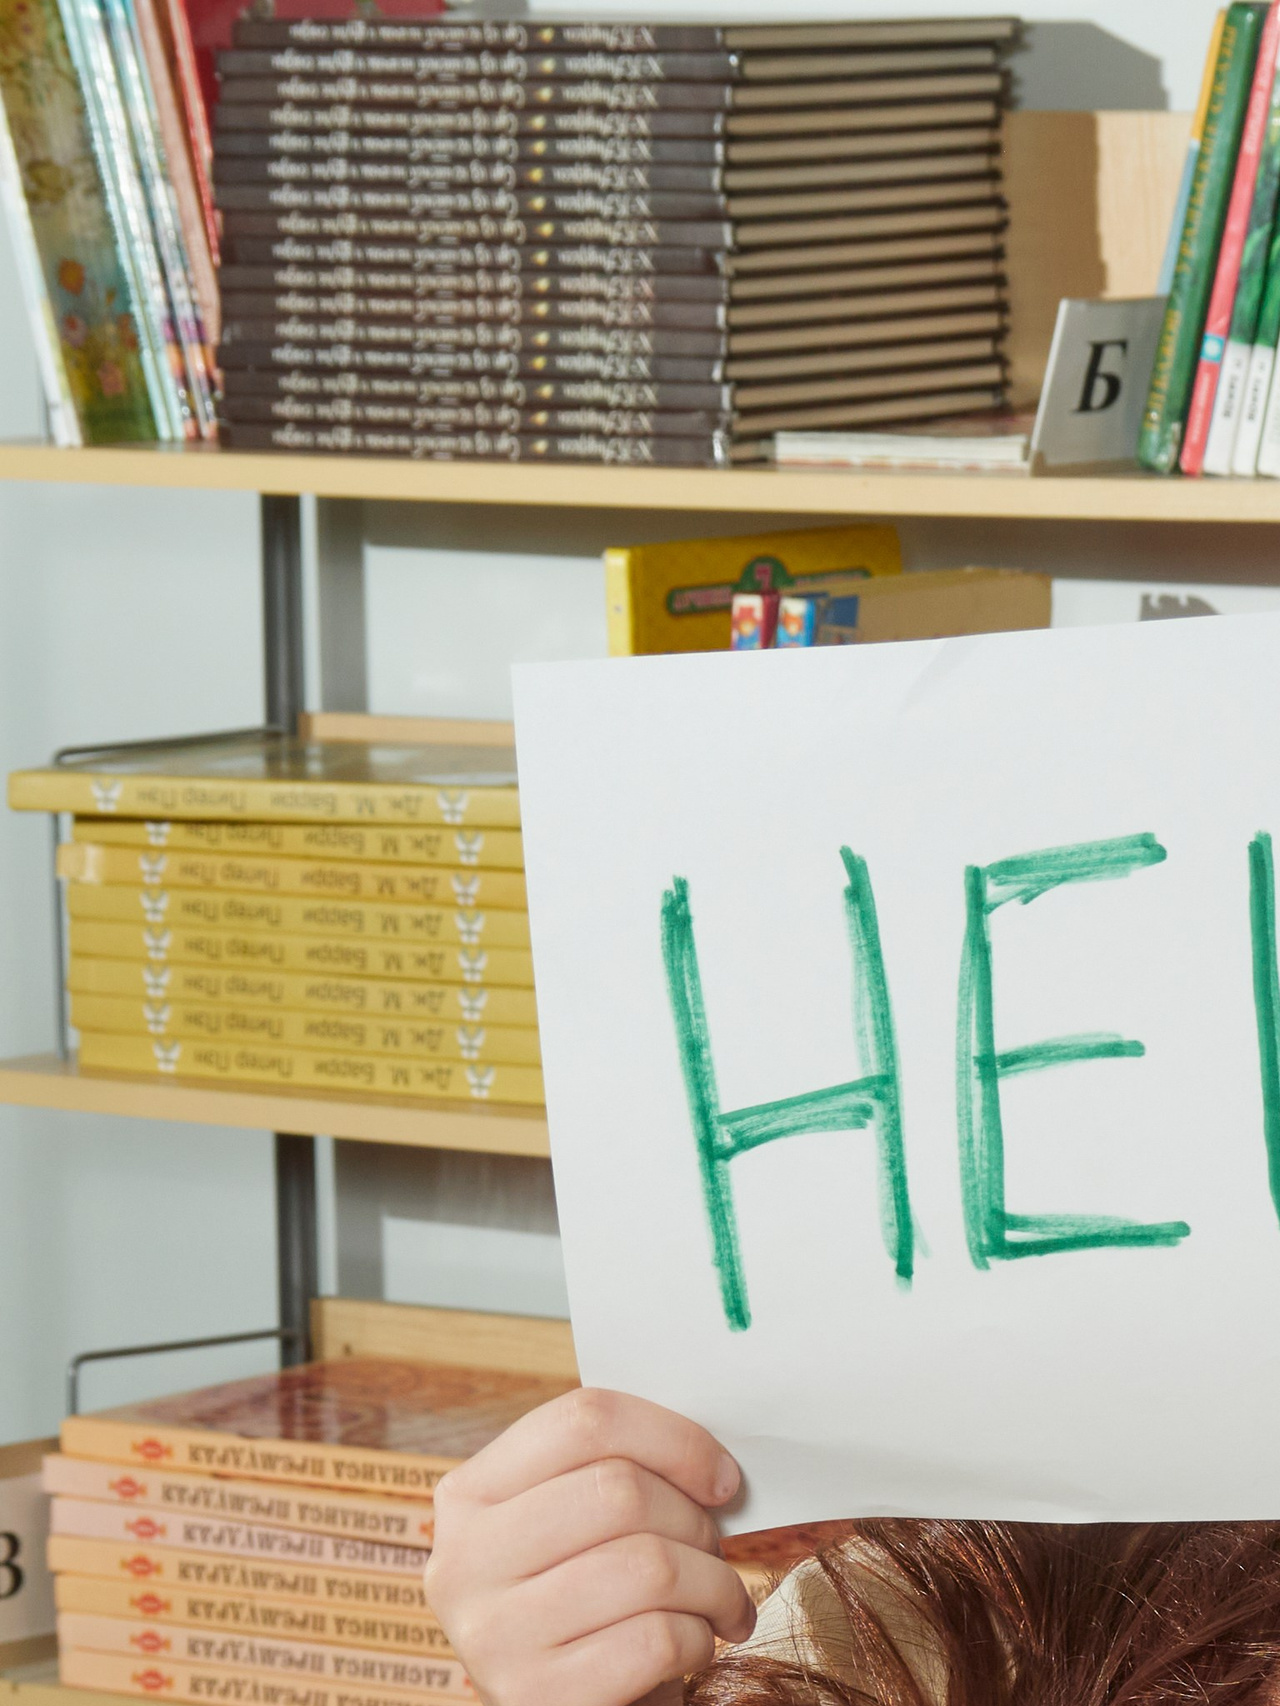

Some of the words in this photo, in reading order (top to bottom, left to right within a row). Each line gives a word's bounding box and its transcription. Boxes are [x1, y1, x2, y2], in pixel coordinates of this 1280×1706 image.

[1073, 339, 1129, 414] Б
[221, 864, 279, 888] Питер
[301, 869, 359, 893] Барри
[373, 875, 395, 896] М.
[403, 876, 437, 898] Дж.
[224, 1013, 283, 1039] Питер
[304, 1019, 365, 1045] Барри
[378, 1027, 400, 1048] М.
[409, 1028, 444, 1051] Дж.
